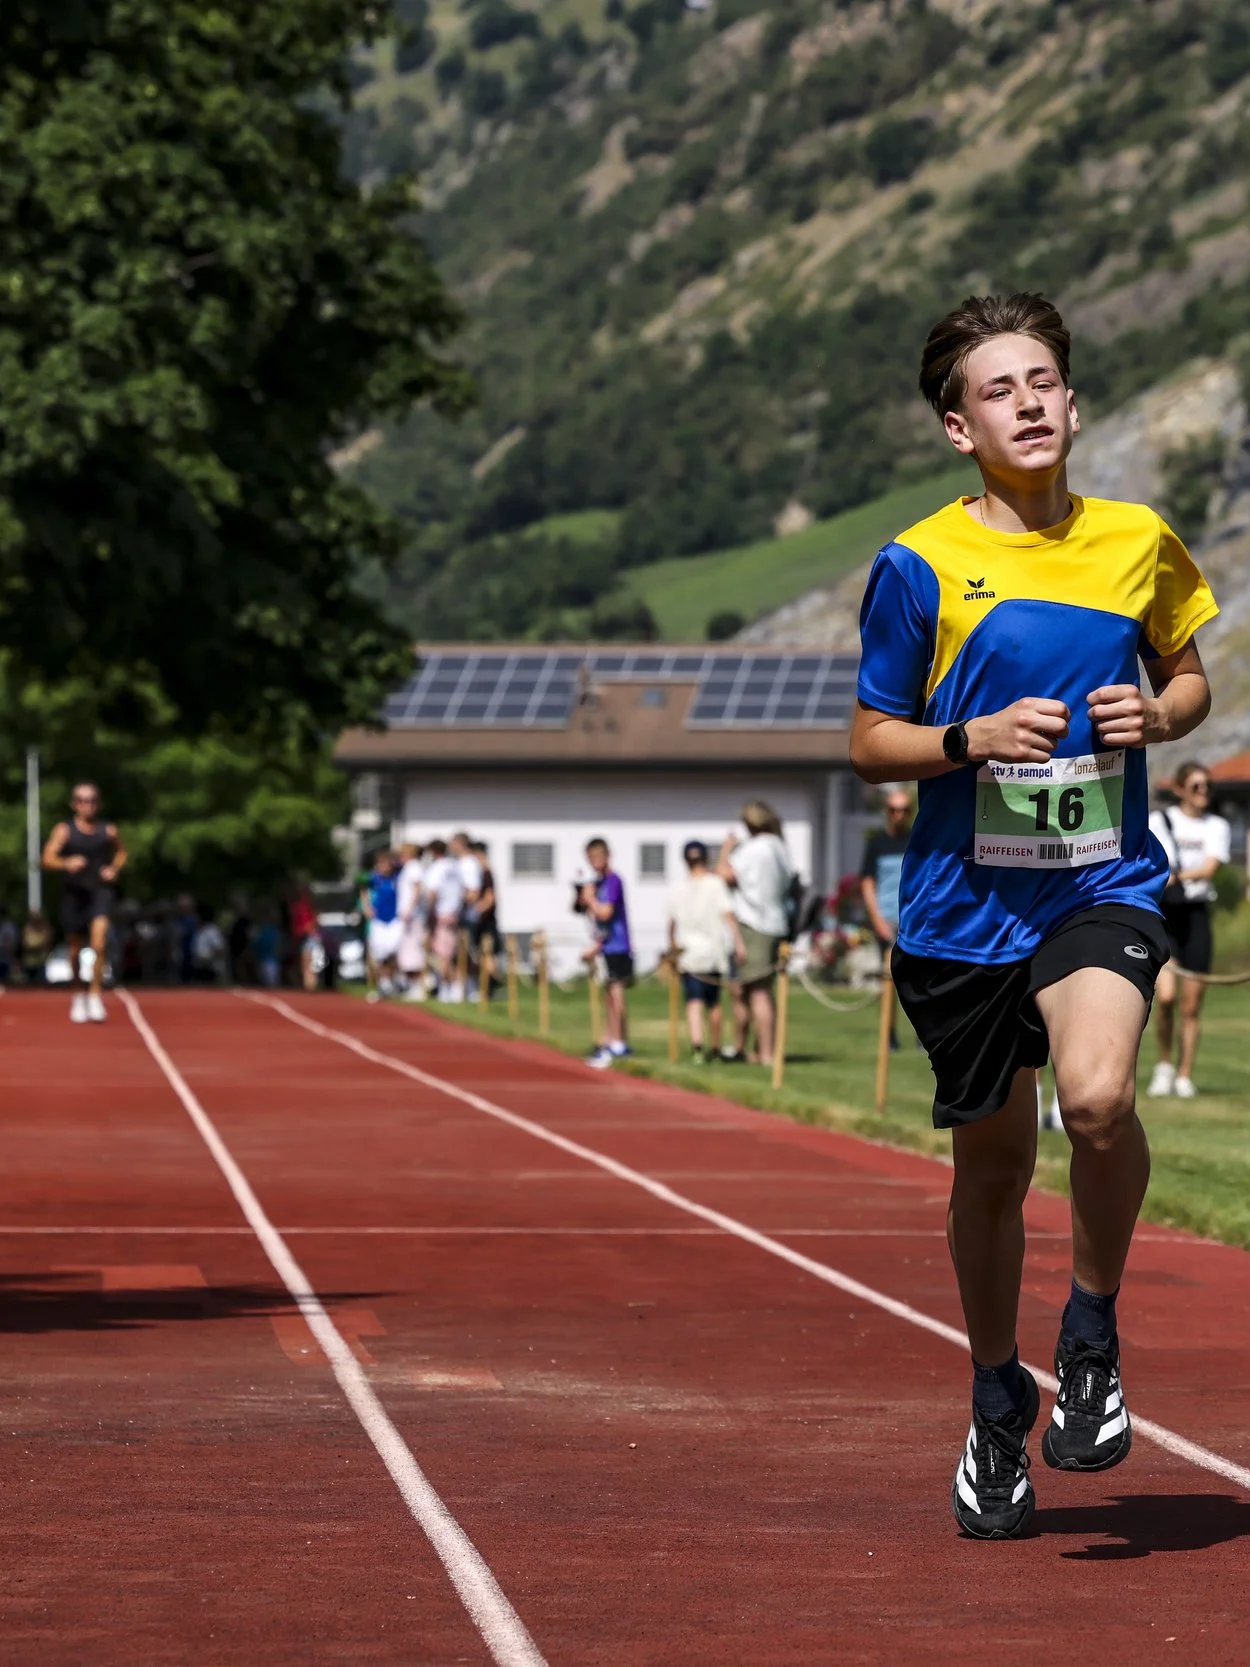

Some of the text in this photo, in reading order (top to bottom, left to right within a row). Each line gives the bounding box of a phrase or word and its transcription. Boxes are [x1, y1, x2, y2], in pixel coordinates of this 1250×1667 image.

[964, 590, 996, 601] erima
[990, 765, 1053, 779] stv gampel
[1074, 757, 1115, 776] lonzalauf
[1028, 787, 1084, 832] 16
[979, 845, 1033, 857] RAIFFEISEN
[1076, 839, 1117, 855] RAIFFEISEN
